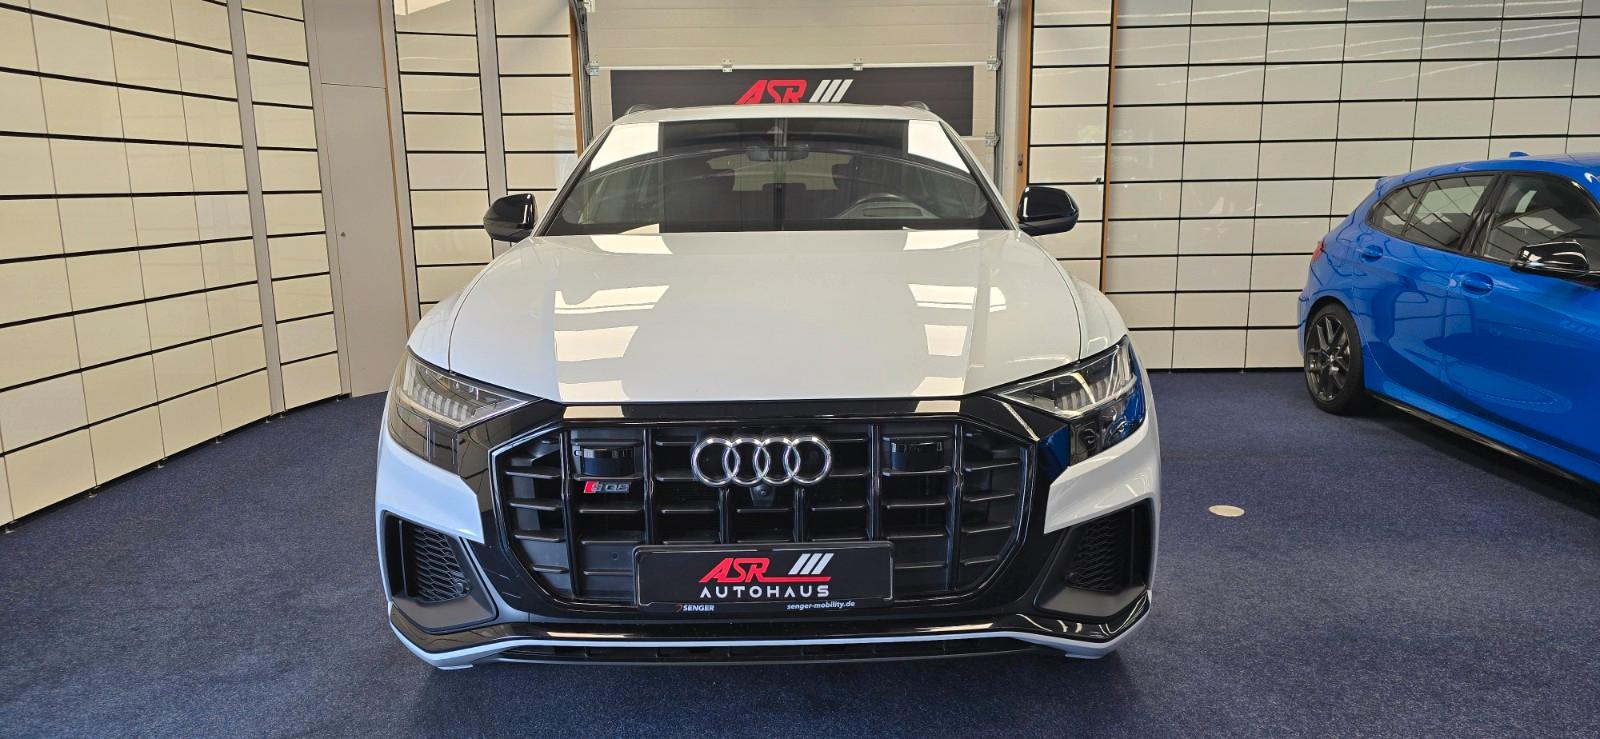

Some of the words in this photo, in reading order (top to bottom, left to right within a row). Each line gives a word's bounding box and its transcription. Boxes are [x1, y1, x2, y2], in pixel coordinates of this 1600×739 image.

[736, 79, 807, 104] ASR
[699, 557, 771, 583] ASR
[700, 584, 830, 599] AUTOHAUS
[682, 604, 715, 612] SENGER
[786, 601, 856, 611] senger-mobility.de
